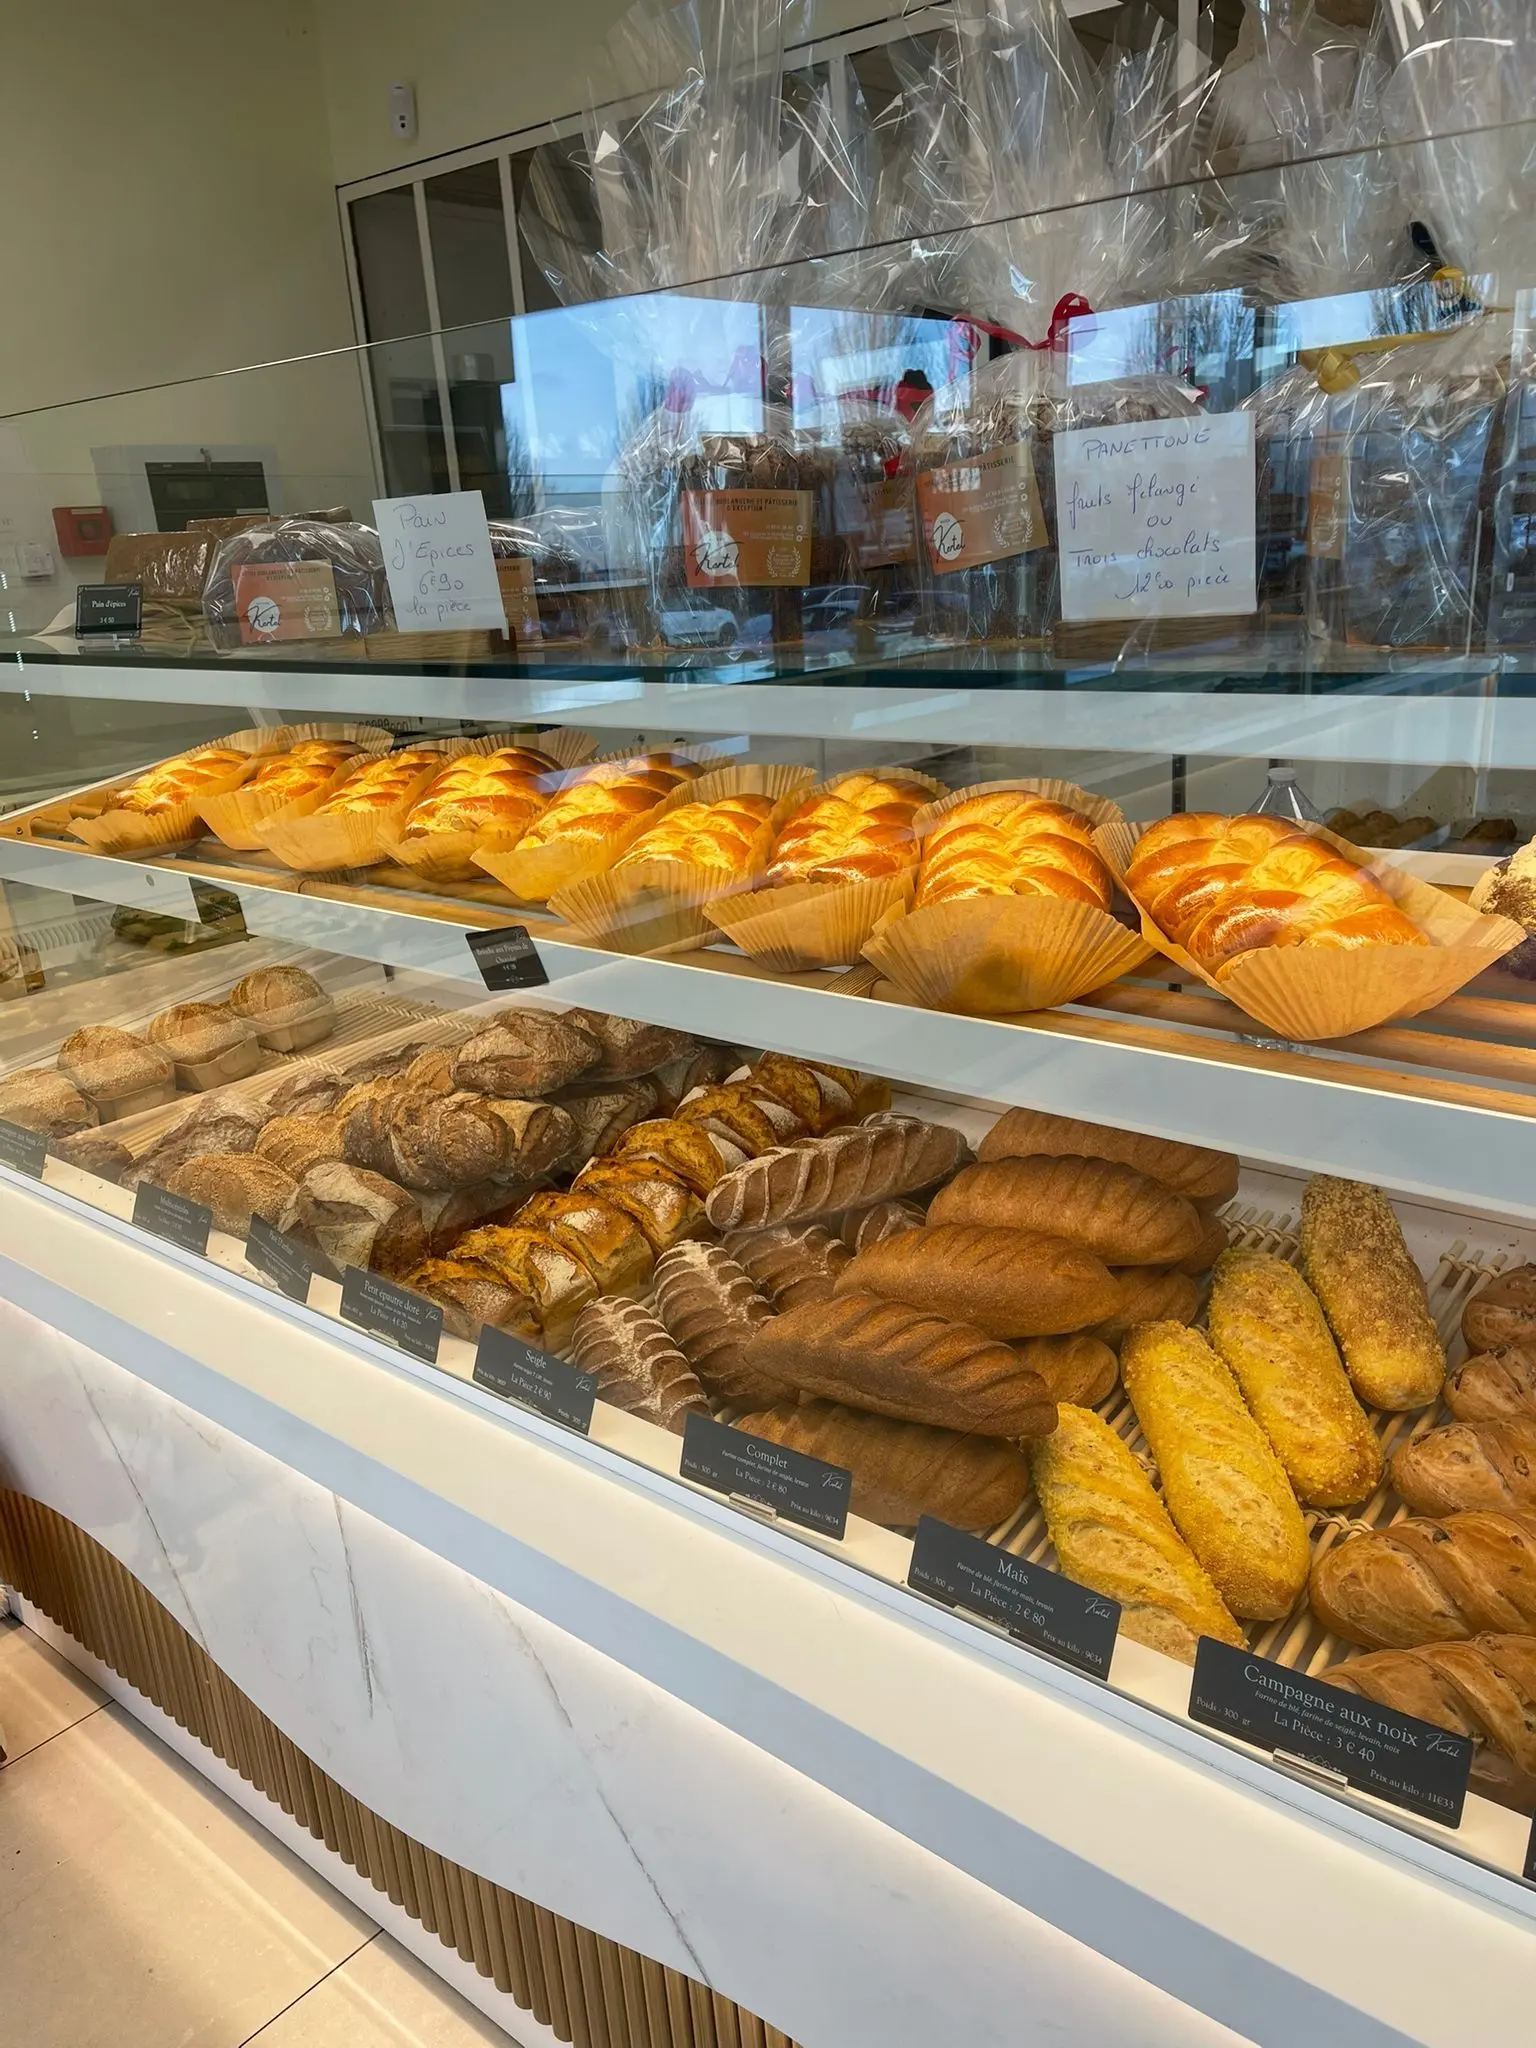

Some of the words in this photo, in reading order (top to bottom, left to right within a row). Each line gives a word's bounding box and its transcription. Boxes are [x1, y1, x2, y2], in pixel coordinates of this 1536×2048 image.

[1083, 428, 1210, 460] PANETTONE
[525, 1349, 547, 1369] Seigle
[746, 1444, 788, 1469] Complet
[998, 1558, 1030, 1585] Maïs
[970, 1581, 981, 1597] La
[984, 1589, 1007, 1608] Pièce
[1015, 1604, 1021, 1615] 2
[1023, 1608, 1031, 1619] €
[1032, 1612, 1046, 1626] 80
[1043, 1629, 1056, 1642] Prix
[1196, 1696, 1218, 1712] Poids
[1224, 1707, 1239, 1720] 300
[1242, 1718, 1251, 1726] gr
[1244, 1664, 1335, 1713] Campagne
[1340, 1706, 1372, 1729] aux
[1377, 1721, 1418, 1747] noix
[1254, 1690, 1278, 1705] Farine
[1278, 1700, 1288, 1708] de
[1288, 1703, 1301, 1715] blé,
[1301, 1709, 1324, 1723] farine
[1324, 1718, 1334, 1727] de
[1335, 1723, 1357, 1738] seigle,
[1358, 1731, 1382, 1748] levain,
[1383, 1743, 1400, 1755] noix
[1274, 1711, 1288, 1727] La
[1292, 1720, 1323, 1742] Pièce
[1335, 1736, 1342, 1749] 3
[1346, 1741, 1355, 1754] €
[1358, 1747, 1375, 1762] 40
[1370, 1768, 1388, 1783] Prix
[1389, 1779, 1400, 1789] au
[1402, 1781, 1420, 1796] kilo
[1428, 1792, 1455, 1810] 11€33
